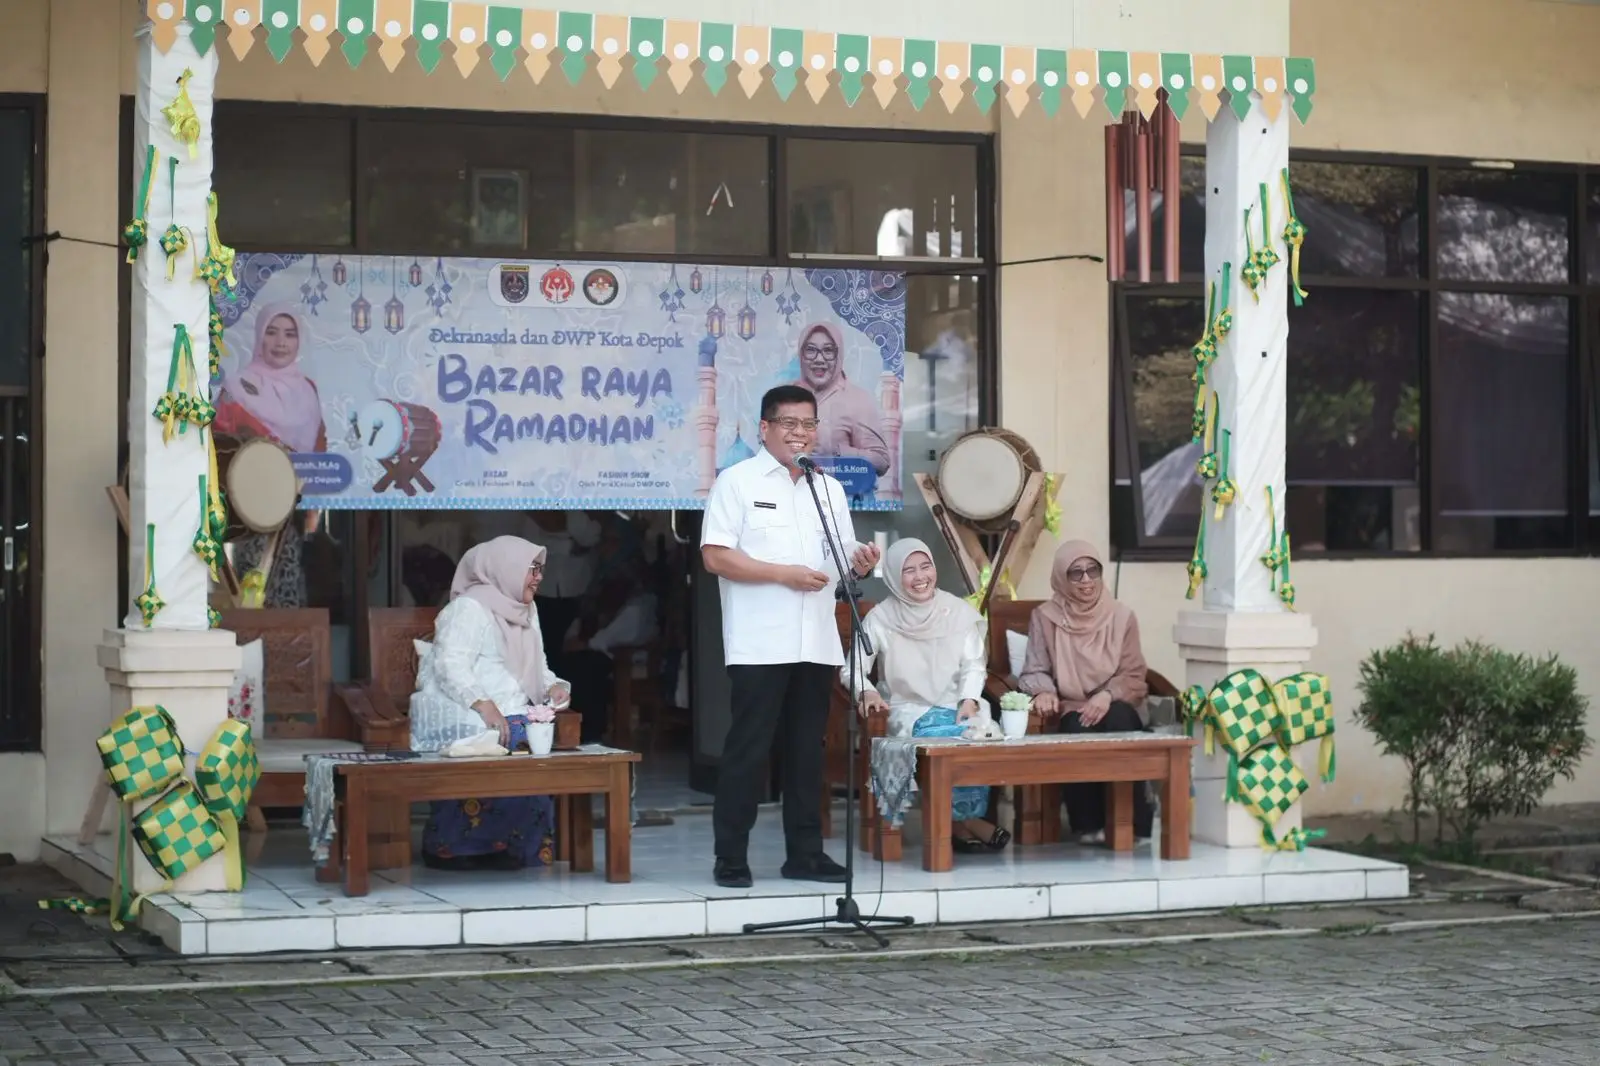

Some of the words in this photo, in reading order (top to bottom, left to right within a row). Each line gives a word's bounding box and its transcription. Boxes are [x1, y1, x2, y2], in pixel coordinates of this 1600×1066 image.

[428, 327, 517, 344] Dekranasda
[520, 328, 549, 345] dan
[551, 330, 596, 346] DWP
[598, 331, 634, 346] Kota
[636, 331, 685, 354] Depok
[437, 354, 564, 403] BAZAR
[464, 399, 654, 455] RAMADHAN
